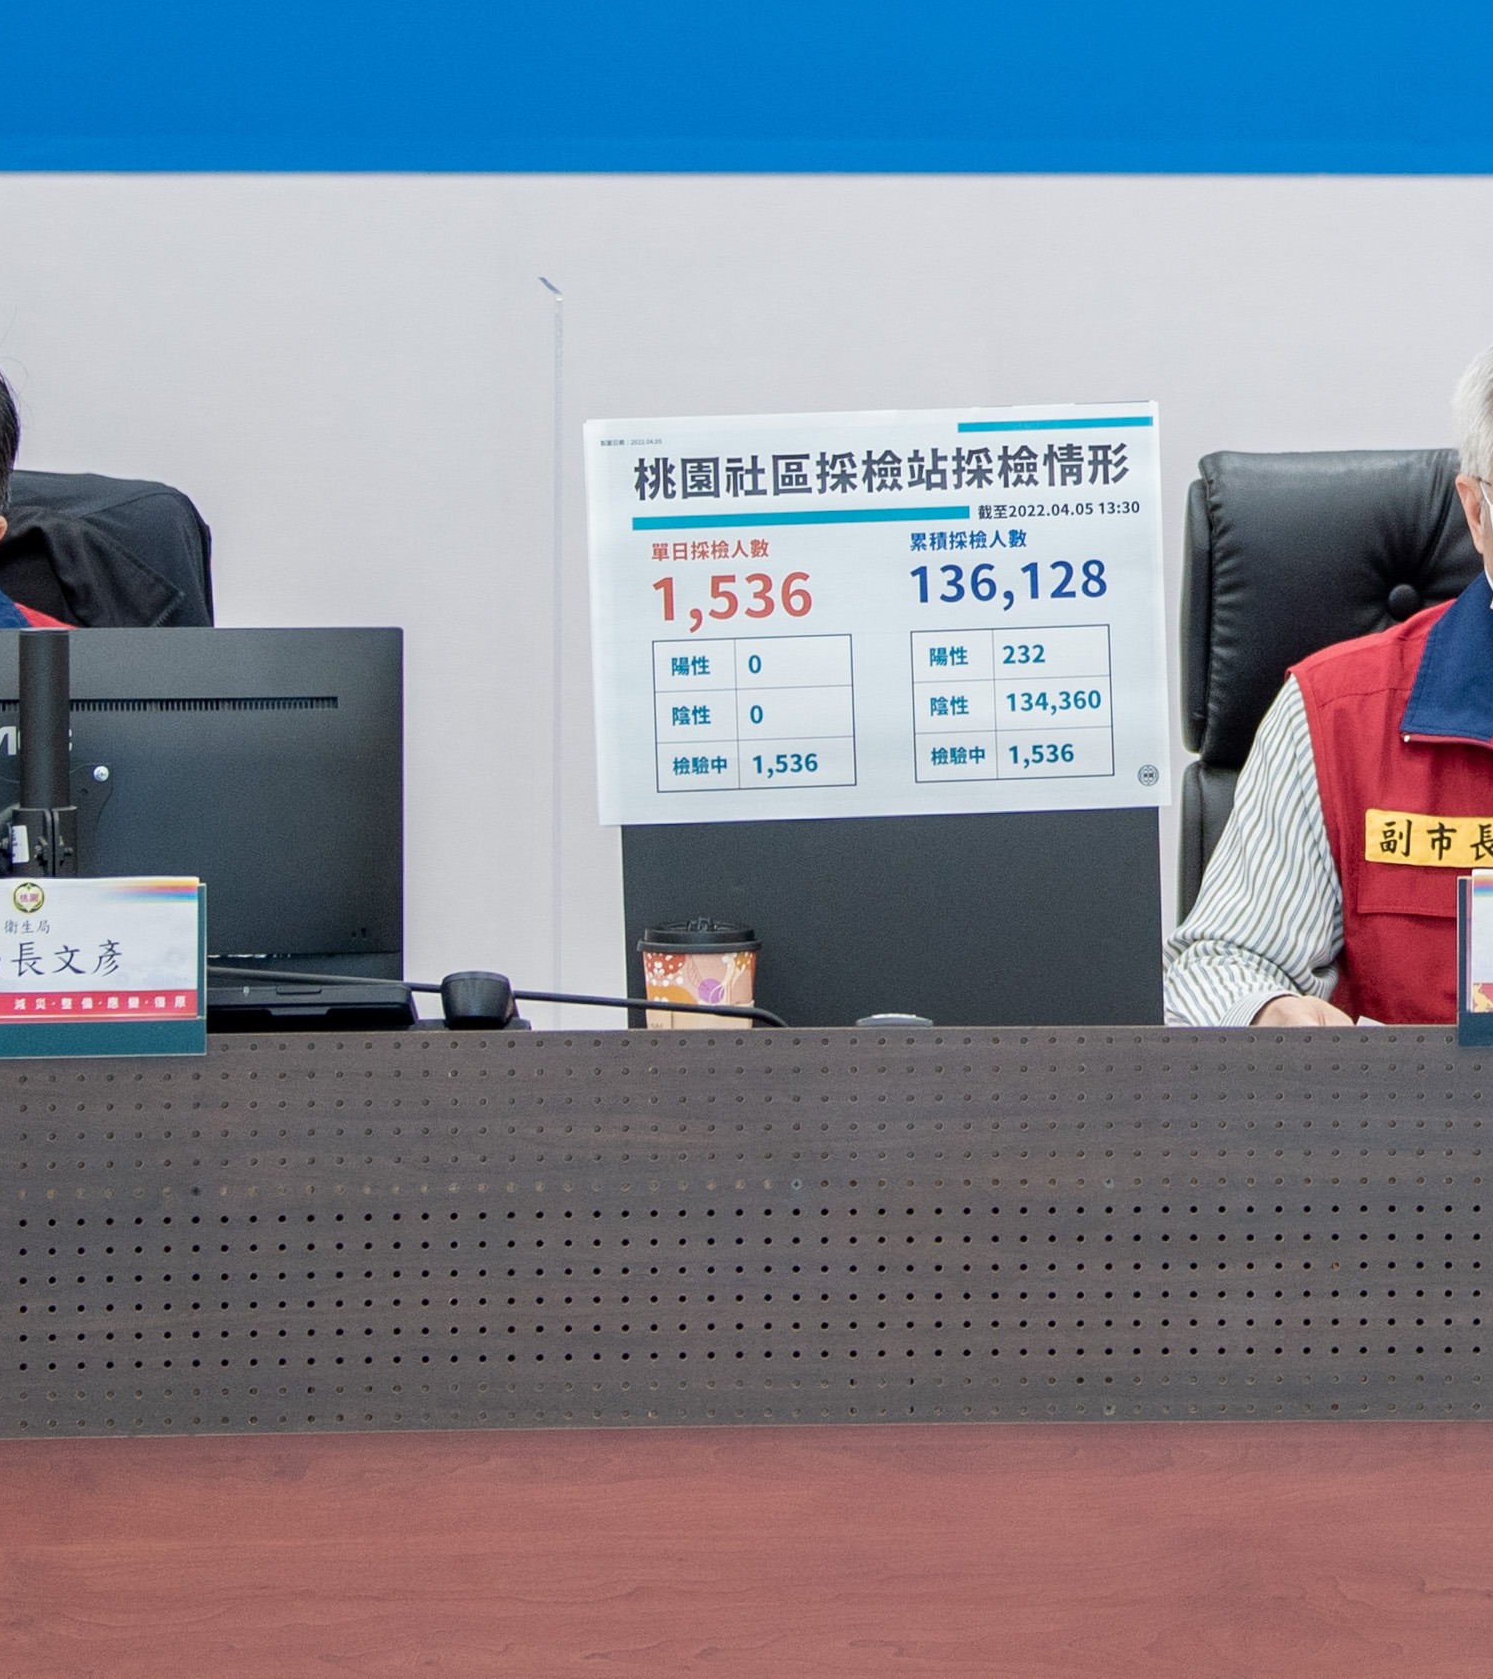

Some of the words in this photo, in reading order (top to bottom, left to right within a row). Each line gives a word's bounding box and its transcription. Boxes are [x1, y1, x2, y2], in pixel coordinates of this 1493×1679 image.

[633, 442, 1129, 501] 桃園社區採檢站採檢情形
[977, 502, 1094, 521] 截至2022.04.05
[1098, 500, 1141, 516] 13:30
[651, 538, 770, 562] 單日採檢人數
[909, 529, 1027, 553] 累積採檢人數
[910, 559, 1108, 611] 136,128
[652, 571, 812, 633] 1,536
[748, 654, 762, 675] 0
[929, 646, 969, 667] 陽性
[1002, 644, 1046, 665] 232
[670, 656, 710, 677] 陽性
[749, 704, 764, 725] 0
[929, 695, 969, 717] 陰性
[1006, 690, 1102, 717] 134,360
[671, 705, 711, 726] 陰性
[672, 755, 728, 776] 檢驗中
[752, 752, 819, 779] 1,536
[930, 745, 986, 767] 檢驗中
[1008, 743, 1074, 770] 1,536
[4, 919, 51, 935] 衛生局
